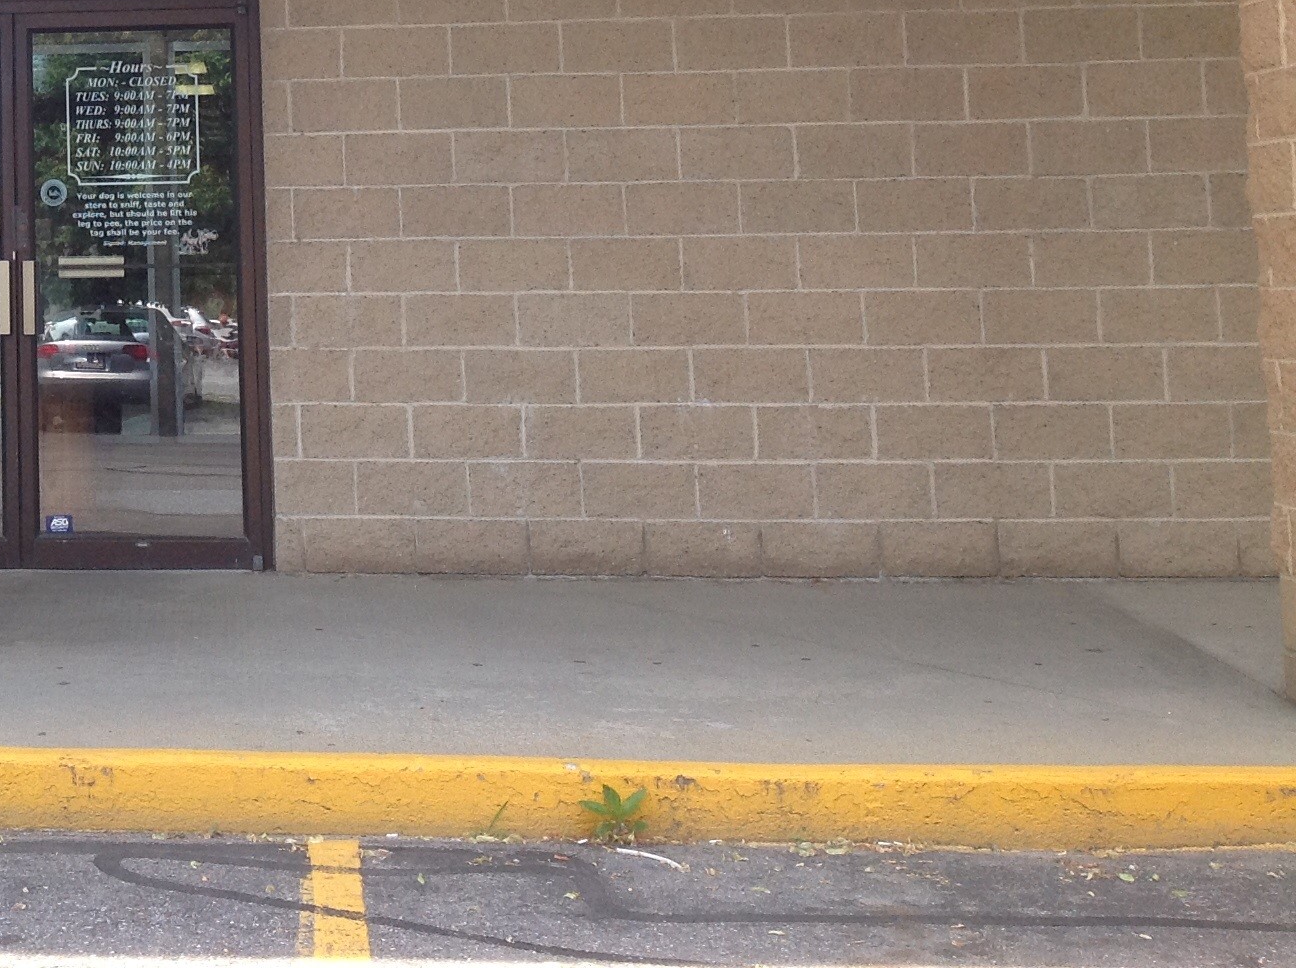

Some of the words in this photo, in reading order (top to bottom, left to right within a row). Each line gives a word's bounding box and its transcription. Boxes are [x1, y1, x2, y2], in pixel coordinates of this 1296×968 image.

[87, 78, 119, 88] MON:
[129, 76, 176, 86] CLOSED
[75, 92, 109, 102] TUES:
[114, 91, 155, 101] 9:00AM
[75, 105, 106, 115] WED:
[114, 105, 155, 114] 9:00AM
[166, 104, 190, 113] 7PM
[75, 119, 112, 129] THURS:
[114, 119, 155, 128] 9:00AM
[166, 118, 190, 127] 7PM
[76, 133, 100, 143] FRI:
[115, 133, 155, 142] 9:00AM
[75, 147, 101, 157] SAT:
[110, 146, 156, 156] 10:00AM
[166, 145, 191, 155] 5PM
[75, 161, 104, 171] SUN:
[110, 160, 156, 170] 10:00AM
[167, 159, 191, 169] 4PM
[99, 192, 115, 201] dog
[72, 211, 107, 219] explore,
[110, 210, 124, 218] but
[77, 220, 90, 228] leg
[141, 219, 162, 228] price
[142, 229, 162, 238] your
